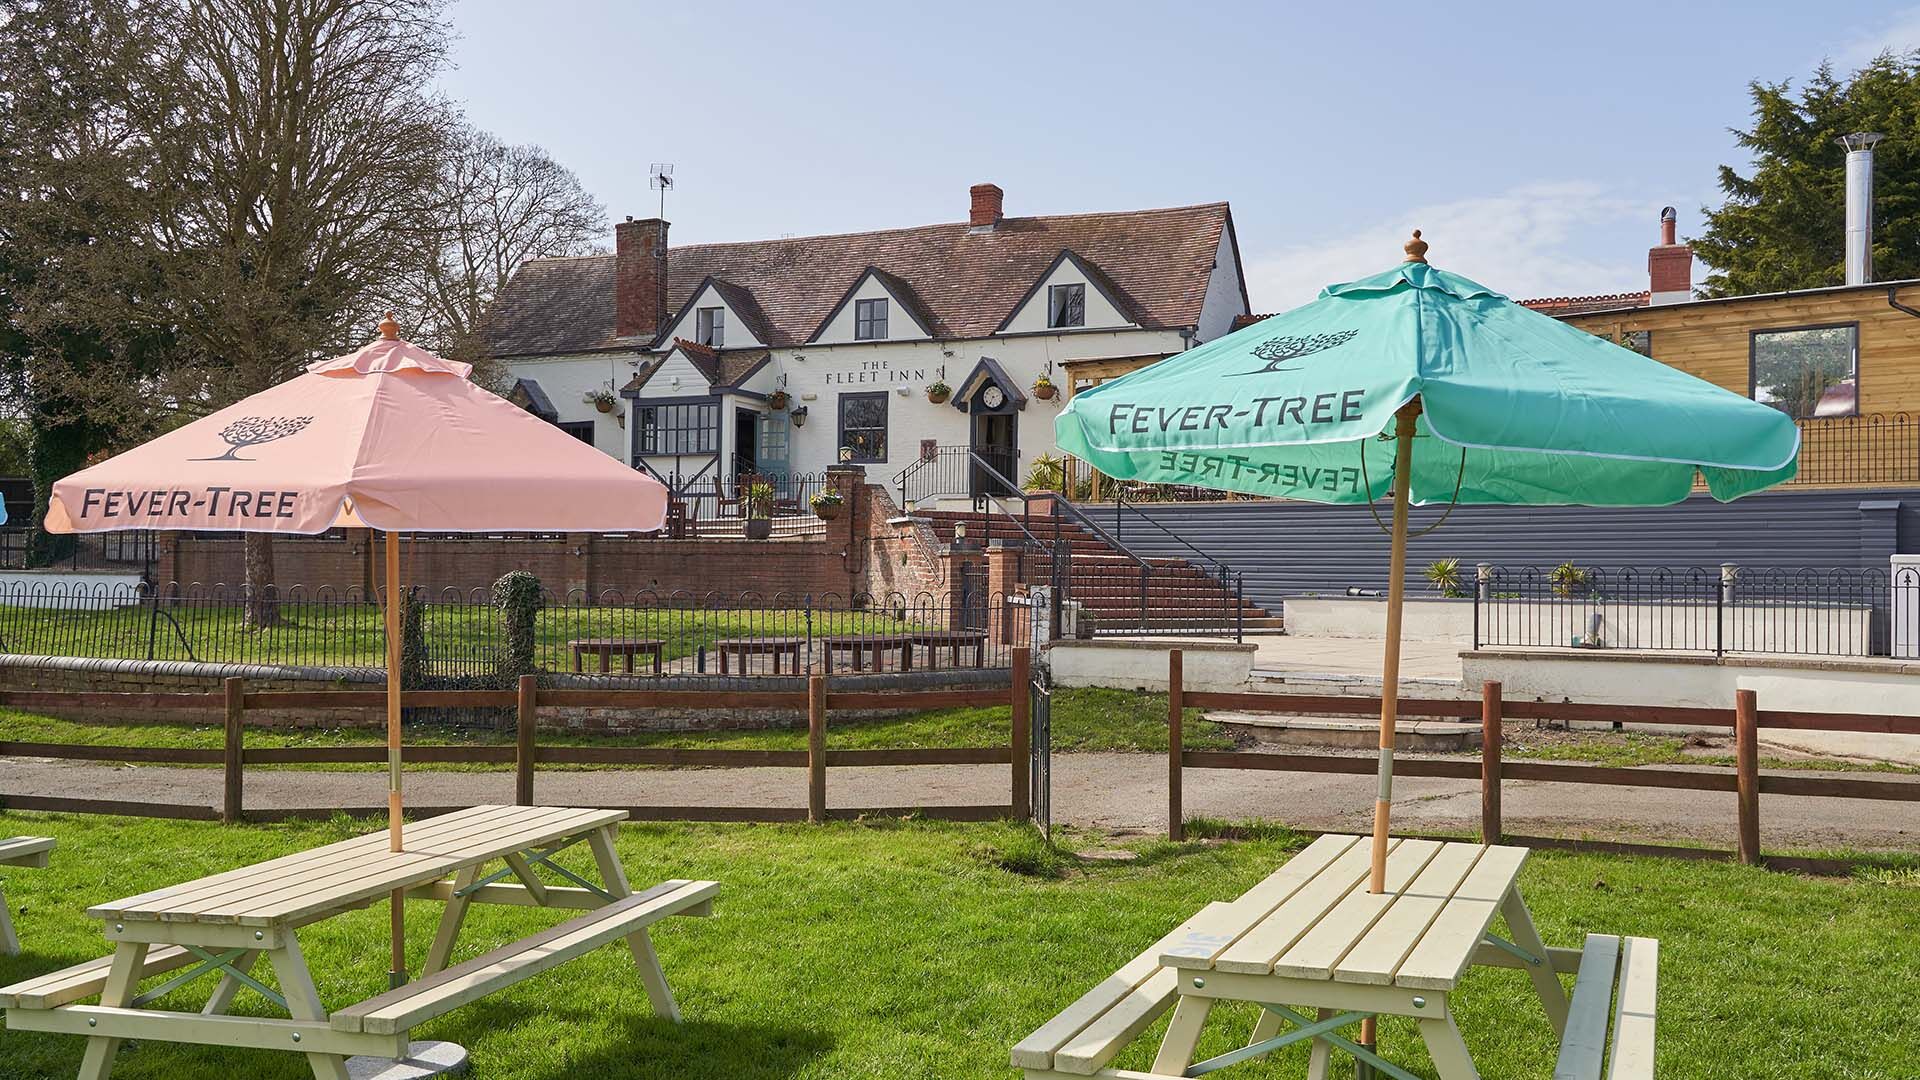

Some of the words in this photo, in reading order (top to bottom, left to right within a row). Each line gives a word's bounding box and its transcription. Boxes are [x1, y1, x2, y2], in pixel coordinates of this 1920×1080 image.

[826, 371, 879, 384] FLEET
[890, 369, 924, 381] INN
[862, 360, 888, 370] THE
[1109, 389, 1365, 434] FEVER-TREE
[80, 486, 299, 518] FEVER-TREE
